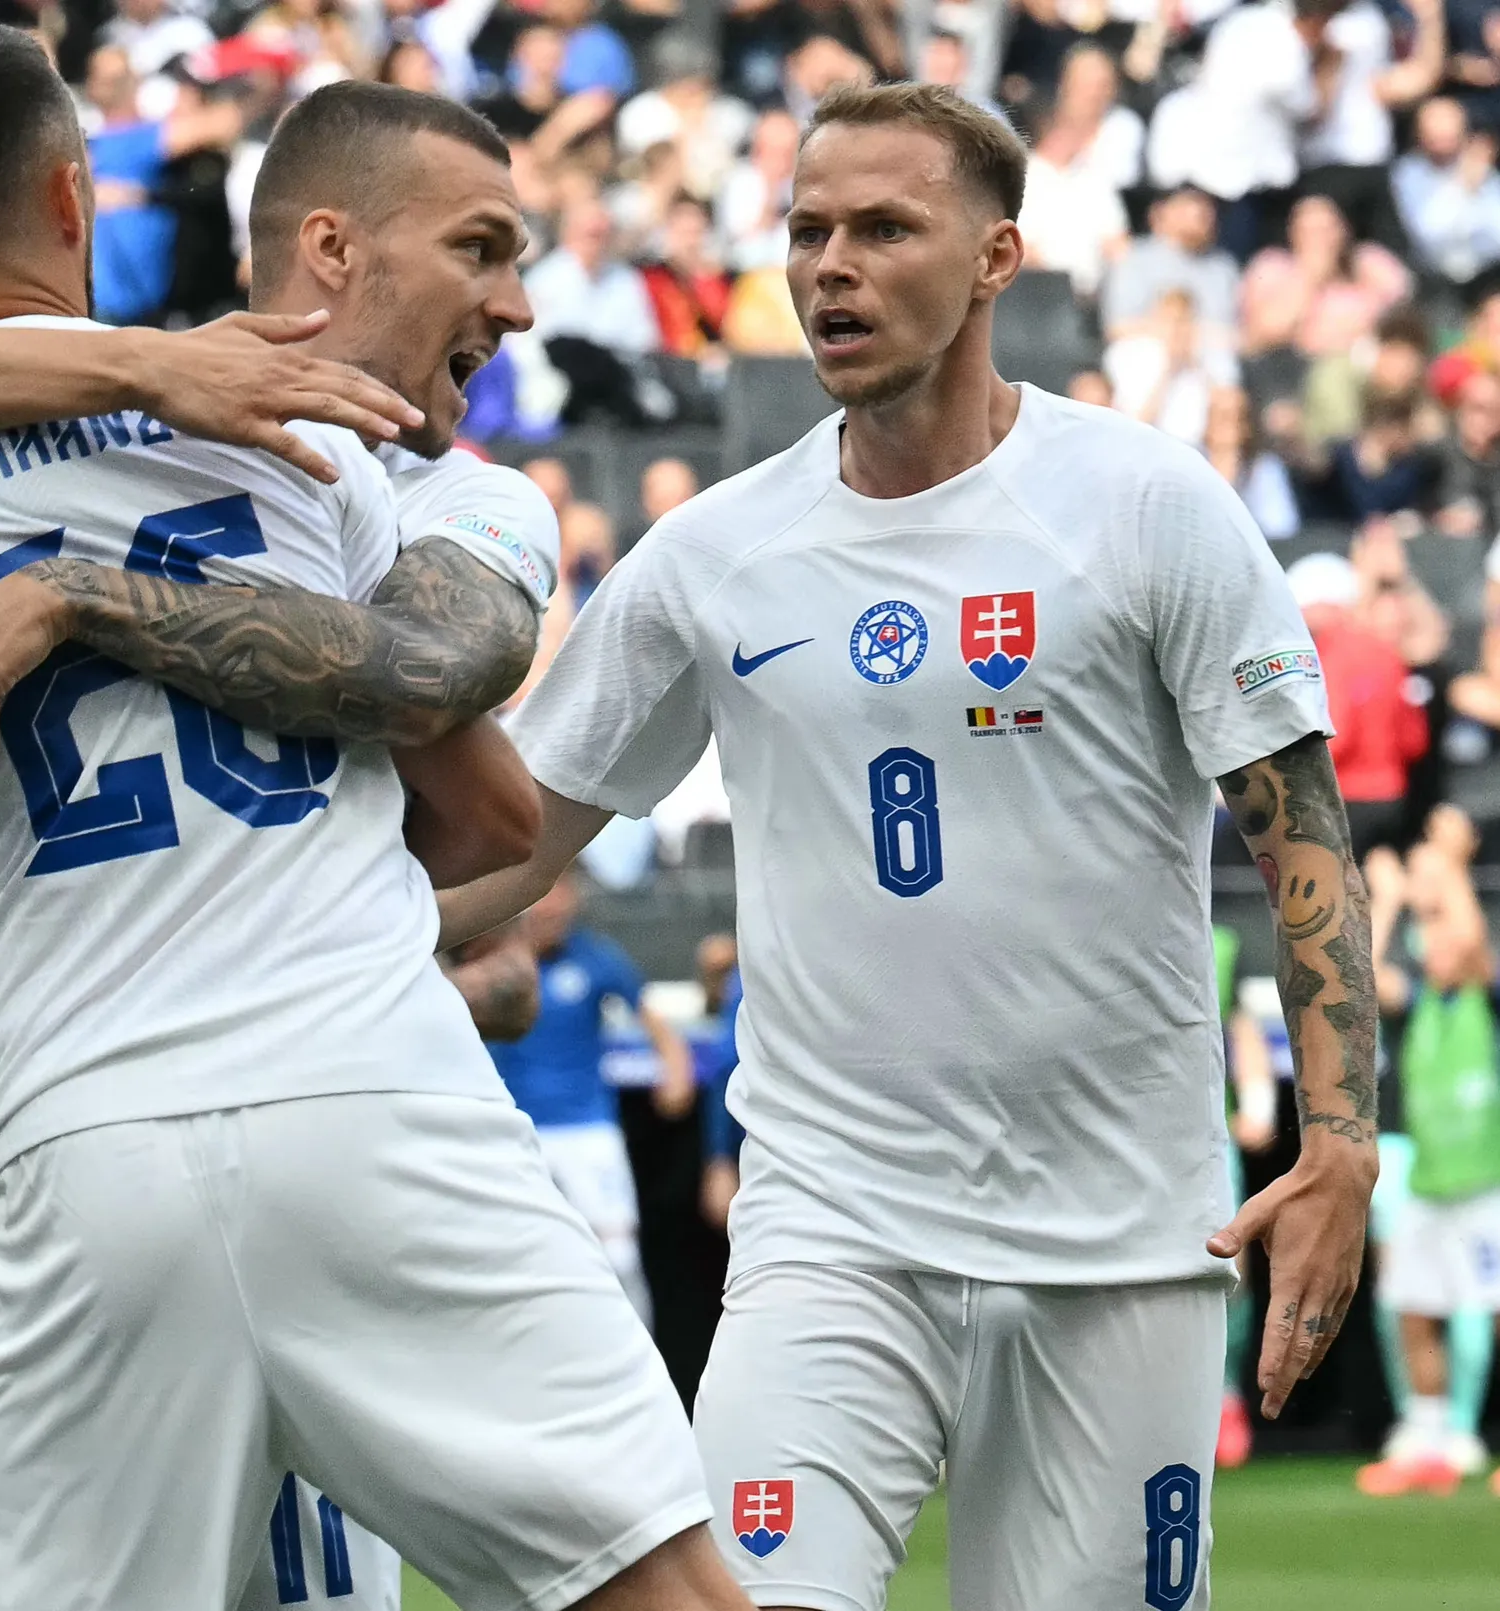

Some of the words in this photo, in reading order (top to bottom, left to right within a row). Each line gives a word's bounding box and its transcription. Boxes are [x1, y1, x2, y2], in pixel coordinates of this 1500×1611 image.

[877, 673, 901, 683] SFZ
[868, 746, 943, 898] 8
[1144, 1463, 1201, 1611] 8
